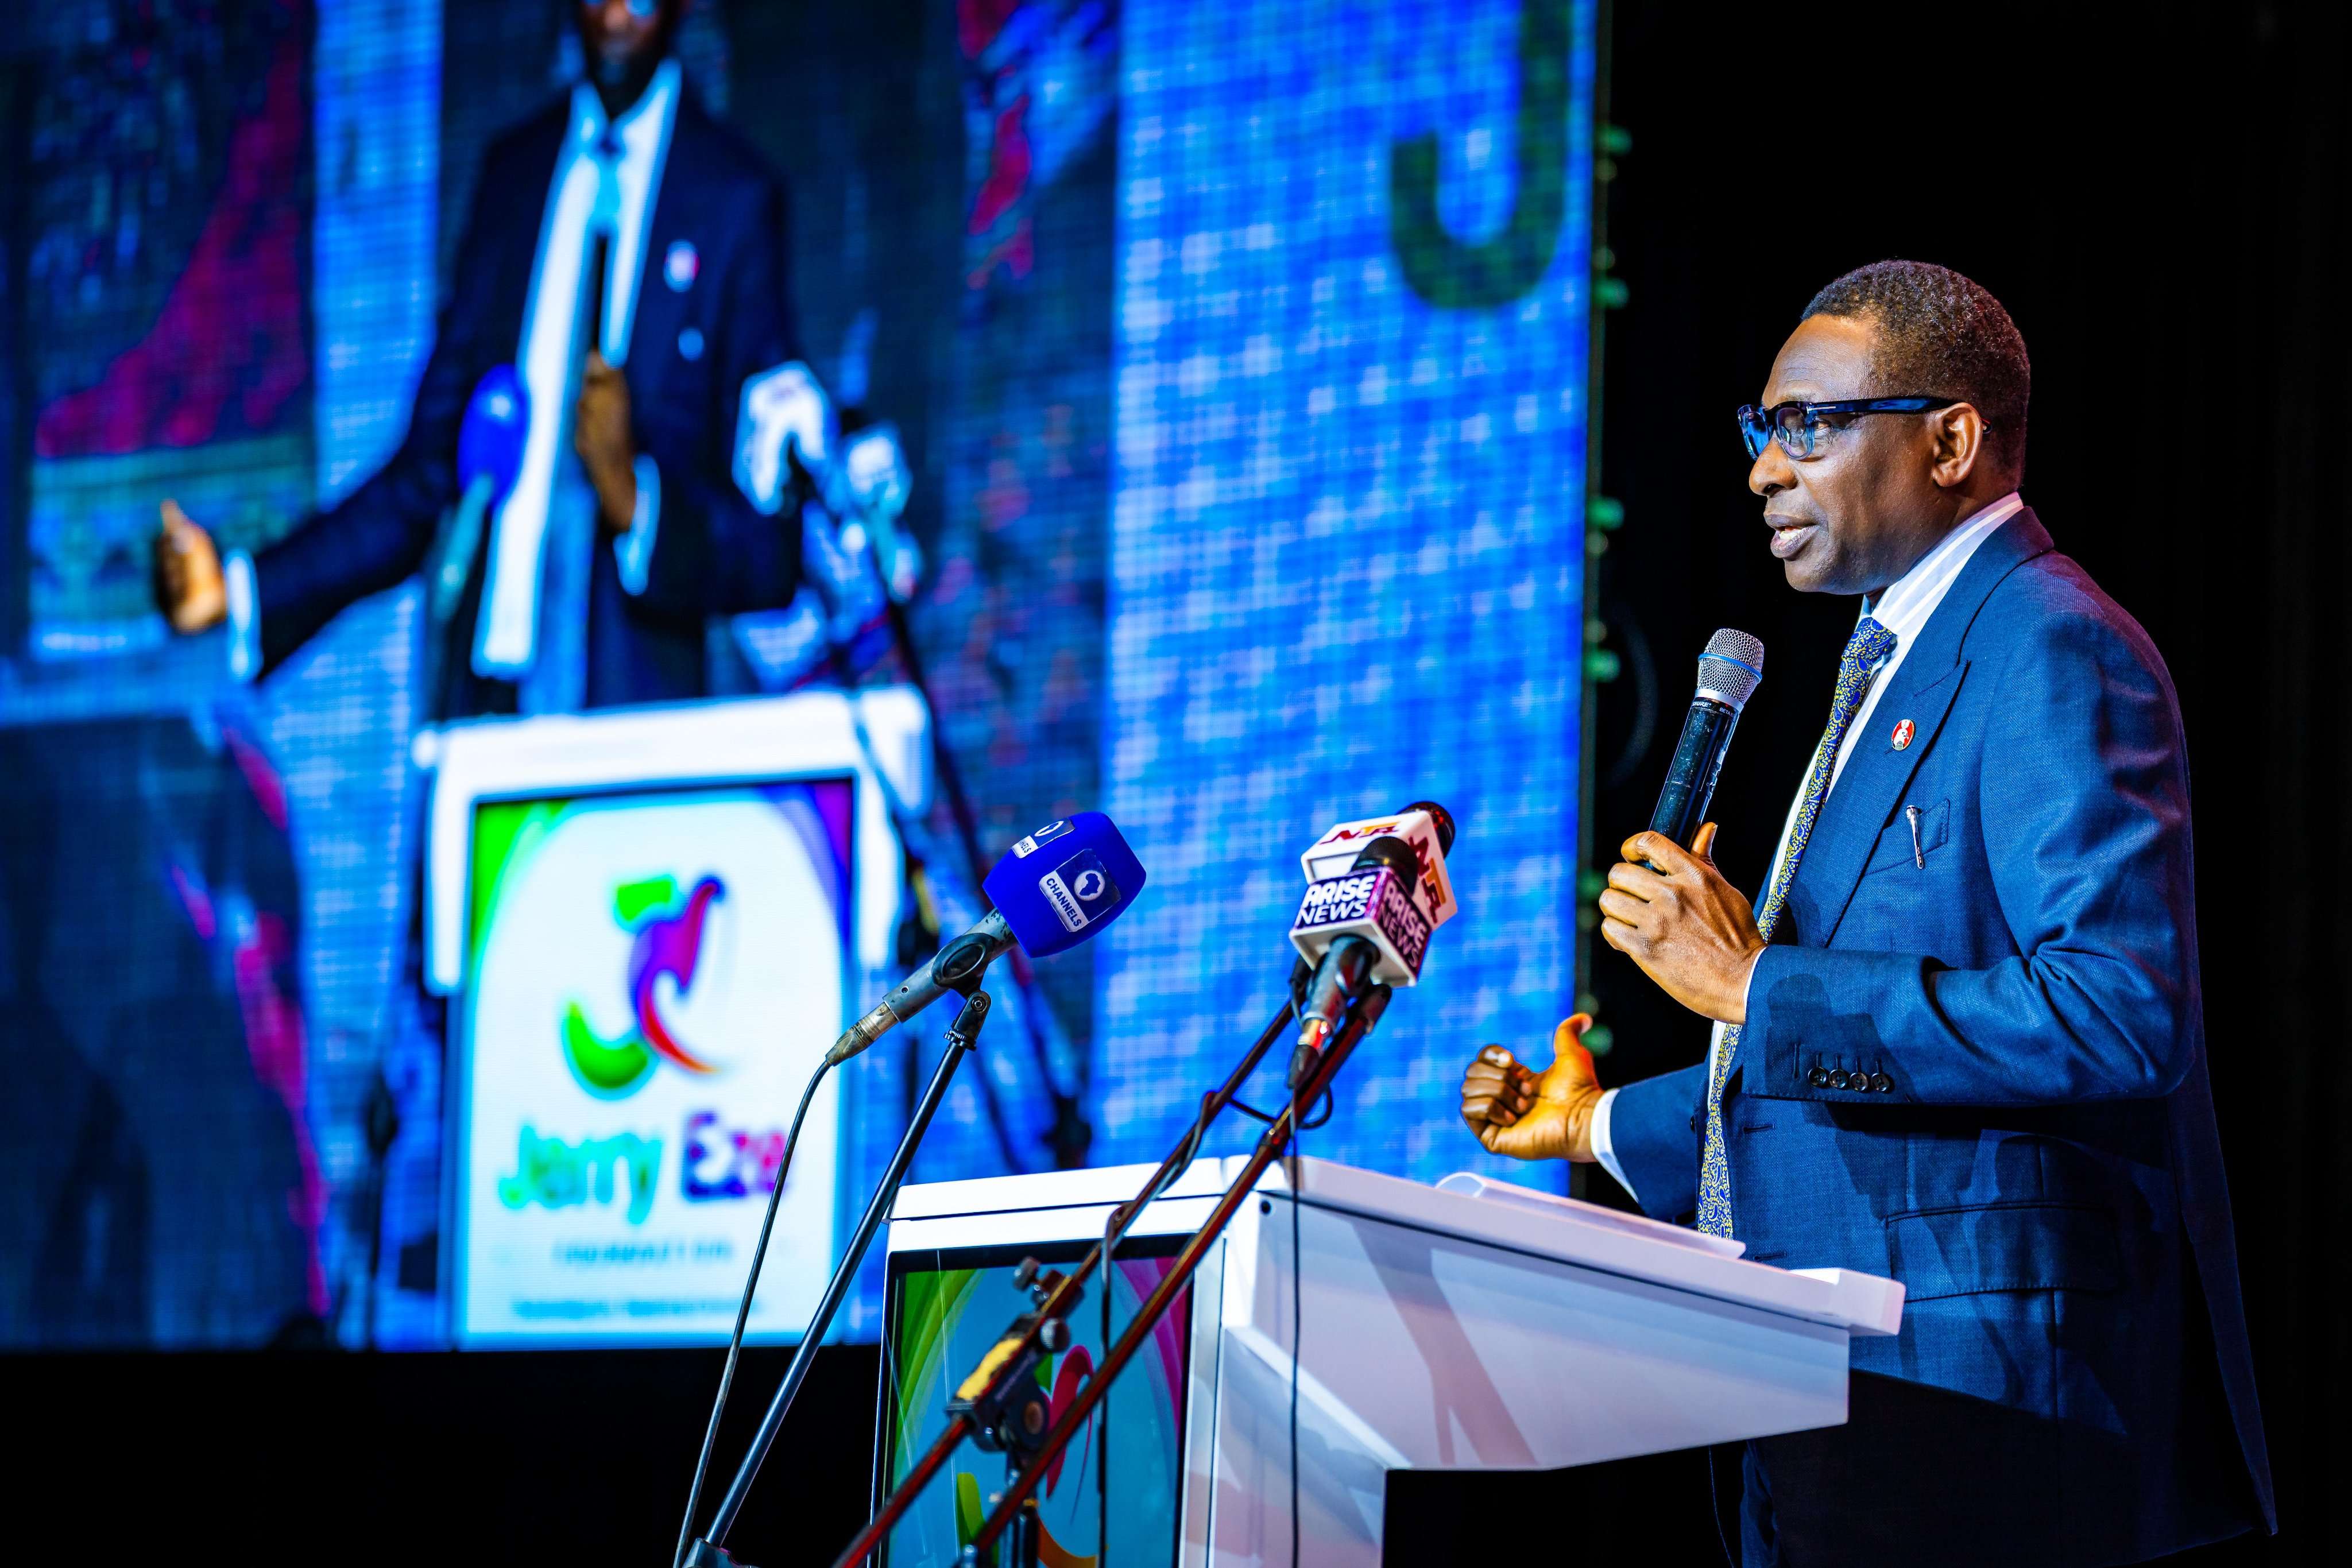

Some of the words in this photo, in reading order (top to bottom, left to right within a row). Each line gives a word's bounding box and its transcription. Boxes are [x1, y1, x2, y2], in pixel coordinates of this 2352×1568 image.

[1719, 707, 1730, 715] BETA
[1046, 878, 1082, 927] CHANNELS
[1302, 874, 1377, 908] ARISE
[1294, 899, 1368, 928] NEWS
[1380, 901, 1419, 967] NEWS
[1383, 880, 1428, 949] ARISE
